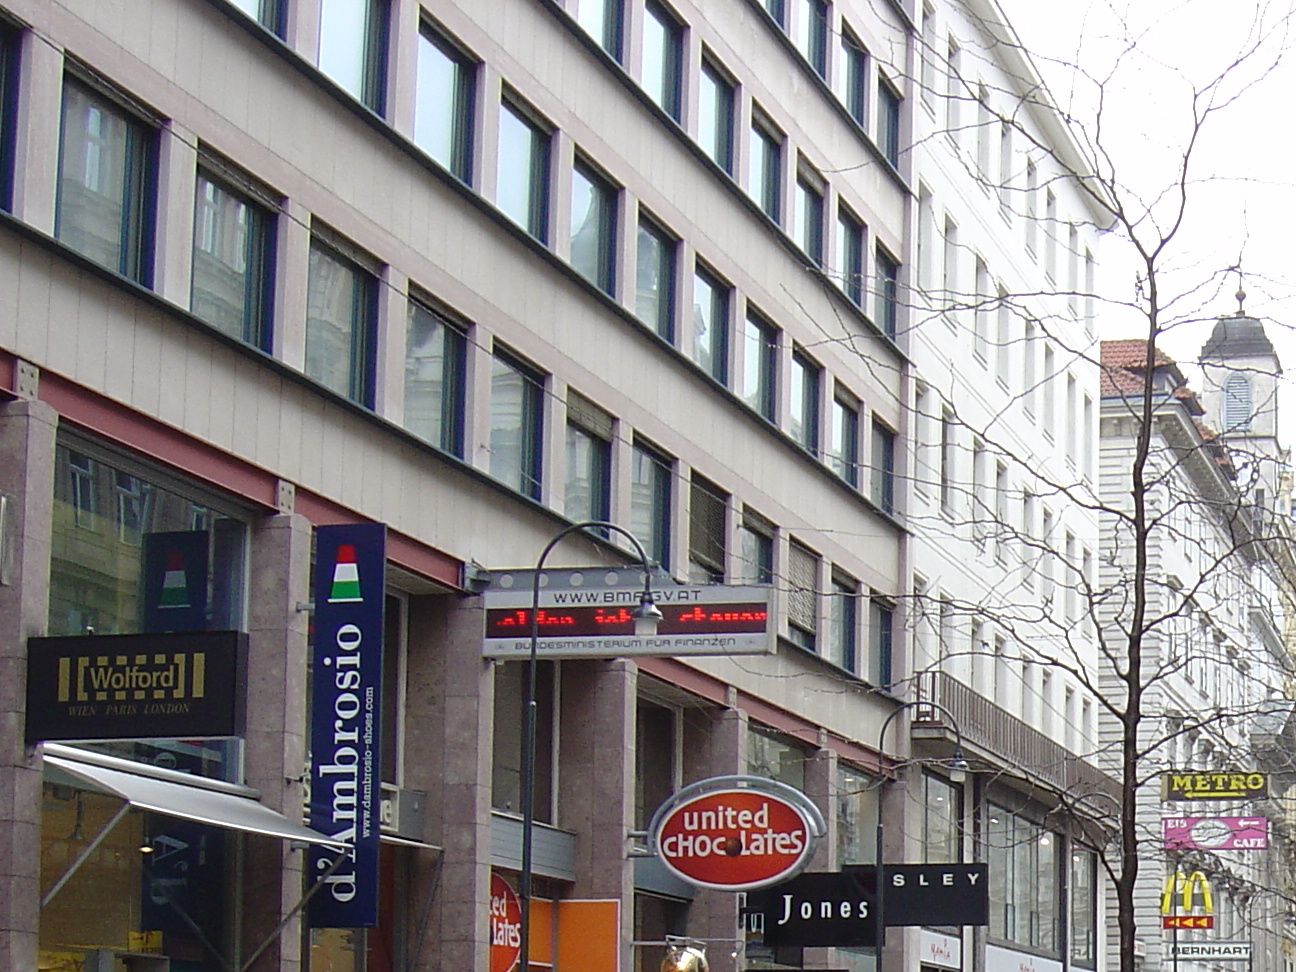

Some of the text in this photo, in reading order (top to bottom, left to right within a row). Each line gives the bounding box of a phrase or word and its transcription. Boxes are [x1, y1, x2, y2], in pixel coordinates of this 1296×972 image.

[646, 638, 670, 648] FÜR
[675, 637, 736, 648] FINANZEN
[90, 665, 174, 689] Wolford
[68, 703, 191, 717] WIEN PARIS LONDON
[317, 623, 362, 902] d'Ambrosio
[362, 686, 374, 838] www.dambrosio-shoes.com
[1172, 773, 1265, 791] METRO
[683, 803, 769, 831] united
[1167, 819, 1187, 829] EIS
[1233, 838, 1265, 848] CAFE
[892, 873, 979, 886] SLEY
[778, 895, 868, 925] Jones
[1172, 946, 1251, 956] BERNHART
